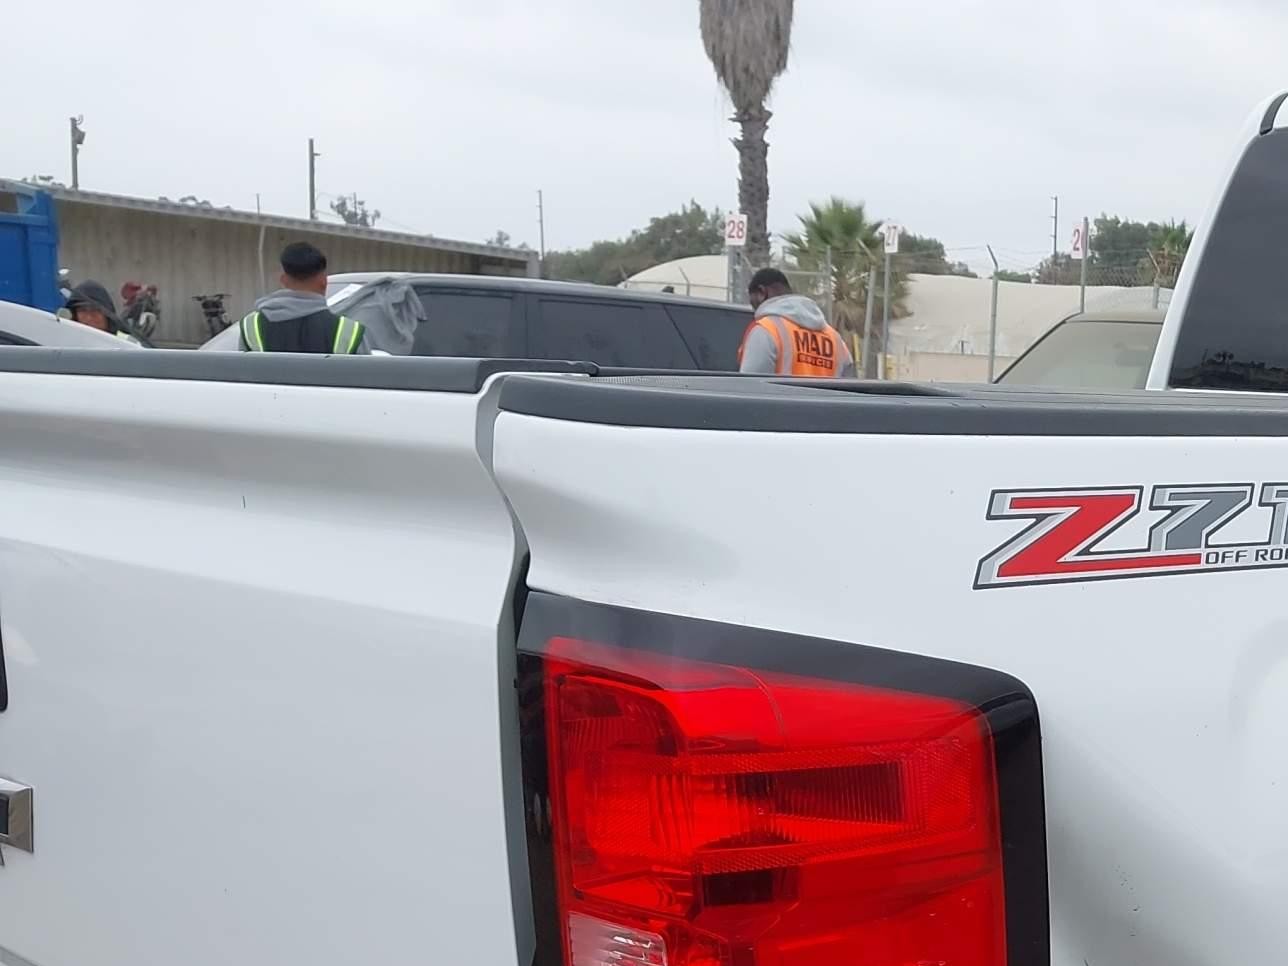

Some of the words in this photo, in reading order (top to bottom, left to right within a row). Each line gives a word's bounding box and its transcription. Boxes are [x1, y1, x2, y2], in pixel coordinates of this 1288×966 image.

[727, 220, 745, 239] 28
[793, 330, 834, 358] MAD
[1205, 549, 1249, 565] OFF
